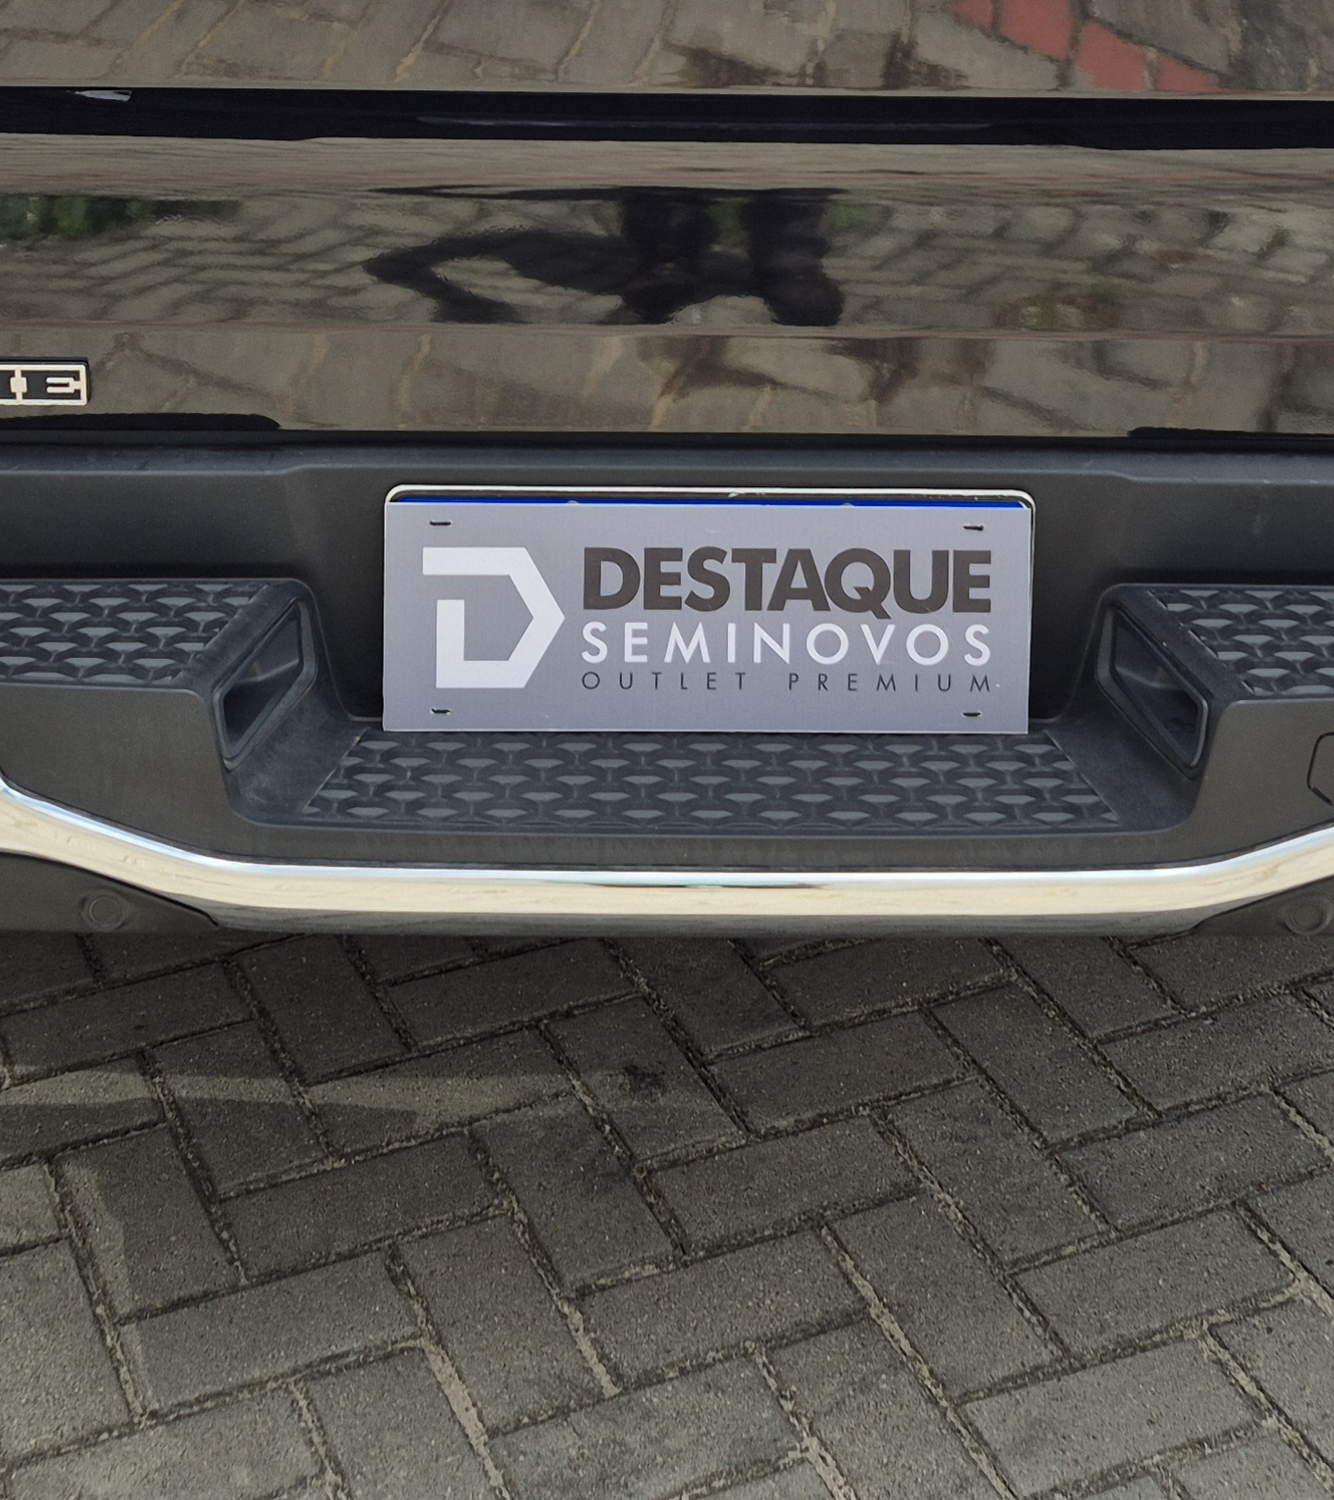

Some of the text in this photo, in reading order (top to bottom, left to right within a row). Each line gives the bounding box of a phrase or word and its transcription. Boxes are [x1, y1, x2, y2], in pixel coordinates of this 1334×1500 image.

[582, 546, 992, 619] DESTAQUE
[581, 621, 991, 666] SEMINOVOS
[581, 671, 991, 692] OUTLET PREMIUM
